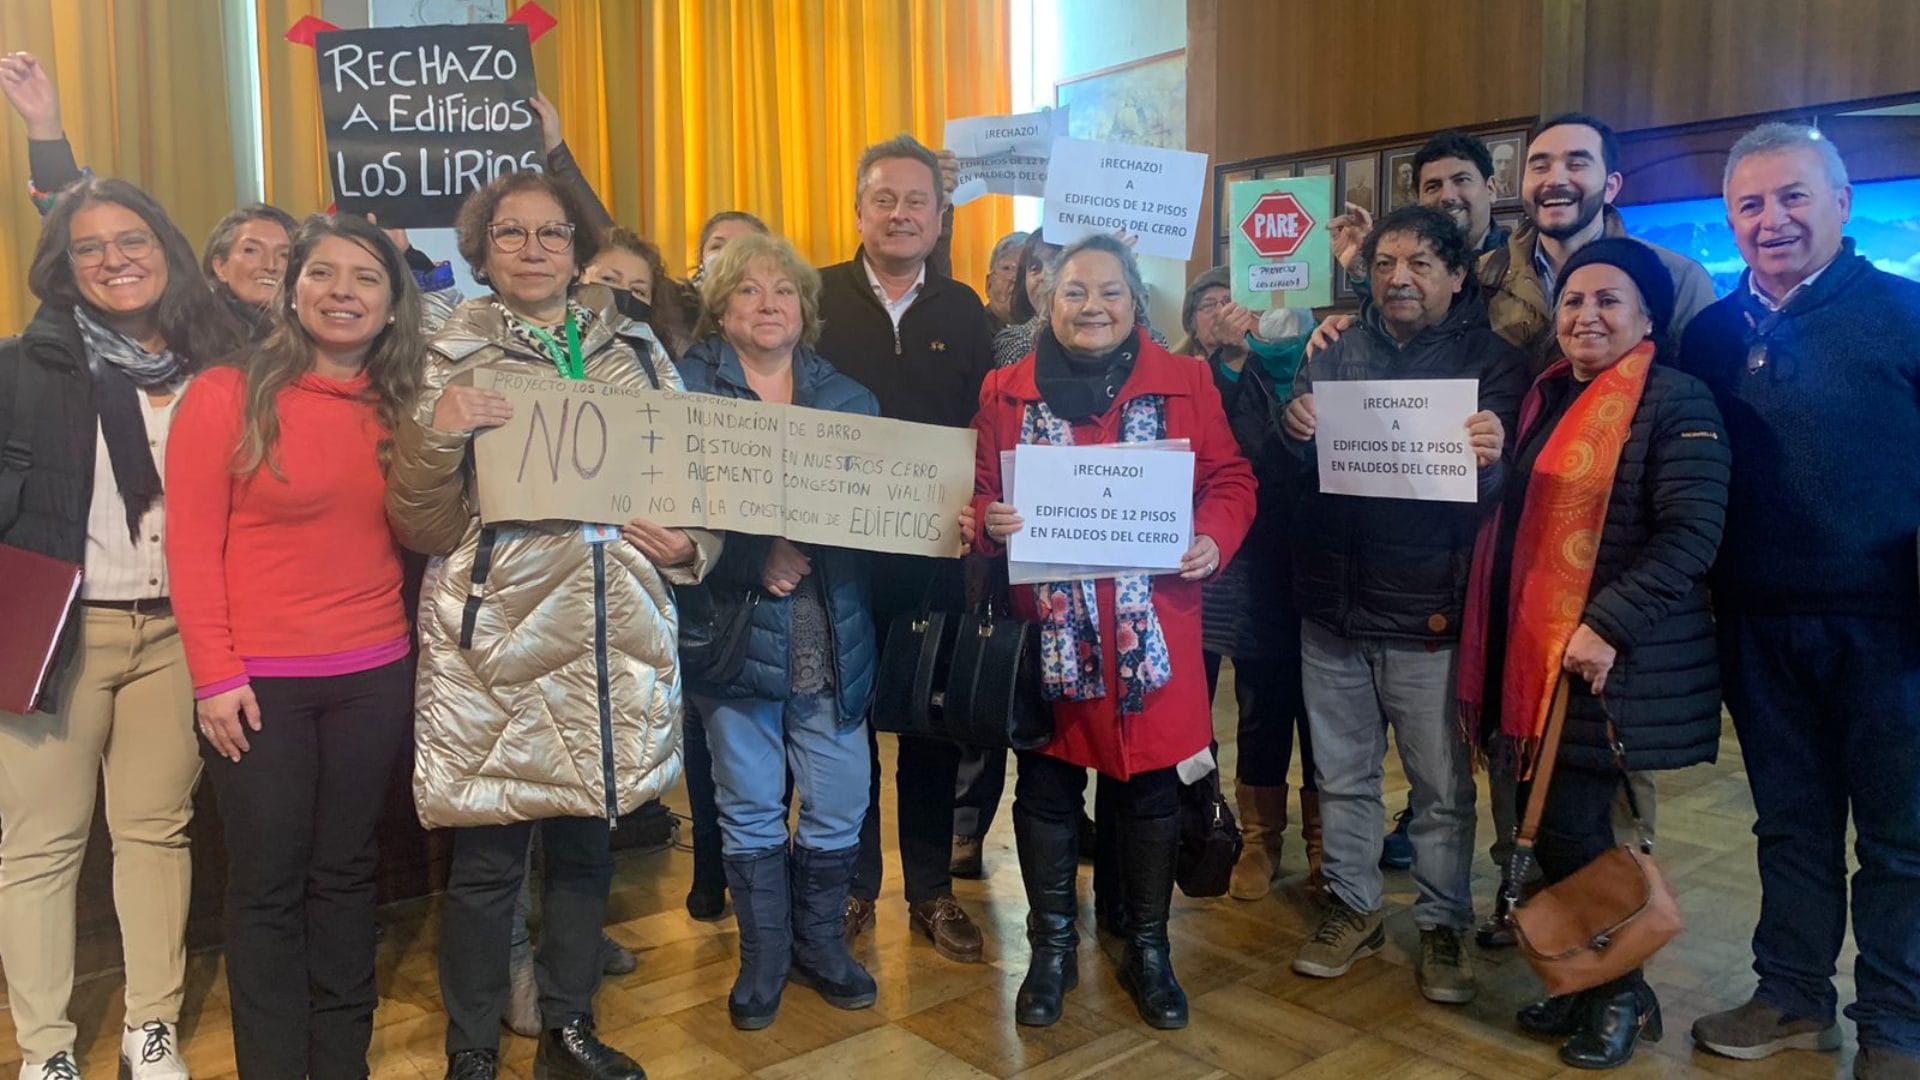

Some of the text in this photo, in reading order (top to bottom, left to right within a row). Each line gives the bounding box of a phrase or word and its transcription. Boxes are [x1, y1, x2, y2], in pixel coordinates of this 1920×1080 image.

[323, 43, 517, 93] RECHAZO
[342, 103, 379, 131] A
[985, 126, 1039, 139] ¡RECHAZO!
[1009, 145, 1017, 154] A
[1100, 158, 1163, 174] ¡RECHAZO!
[959, 174, 972, 185] EN
[1125, 179, 1135, 190] A
[1065, 193, 1188, 218] EDIFICIOS DE 12 PISOS
[1058, 212, 1187, 238] EN FALDEOS DEL CERRO
[1254, 212, 1299, 239] PARE
[493, 371, 567, 393] PROYECTO
[572, 382, 596, 394] LOS
[602, 386, 641, 398] LIRIOS
[1363, 397, 1429, 410] ¡RECHAZO!
[788, 421, 806, 437] DE
[816, 421, 862, 442] BARRO
[1391, 419, 1400, 430] A
[517, 398, 607, 485] NO
[1333, 440, 1463, 454] EDIFICIOS DE 12 PISOS
[781, 448, 797, 467] EN
[890, 460, 939, 479] CERRO
[1073, 464, 1144, 478] ¡RECHAZO!
[1331, 460, 1467, 477] EN FALDEOS DEL CERRO
[782, 472, 871, 497] CONGESTION
[887, 484, 920, 502] VIAL
[1102, 487, 1112, 498] A
[611, 494, 632, 513] NO
[649, 497, 676, 514] NO
[691, 497, 702, 514] A
[709, 499, 726, 515] LA
[824, 512, 841, 527] DE
[1036, 505, 1177, 523] EDIFICIOS DE 12 PISOS
[1030, 526, 1180, 544] EN FALDEOS DEL CERRO
